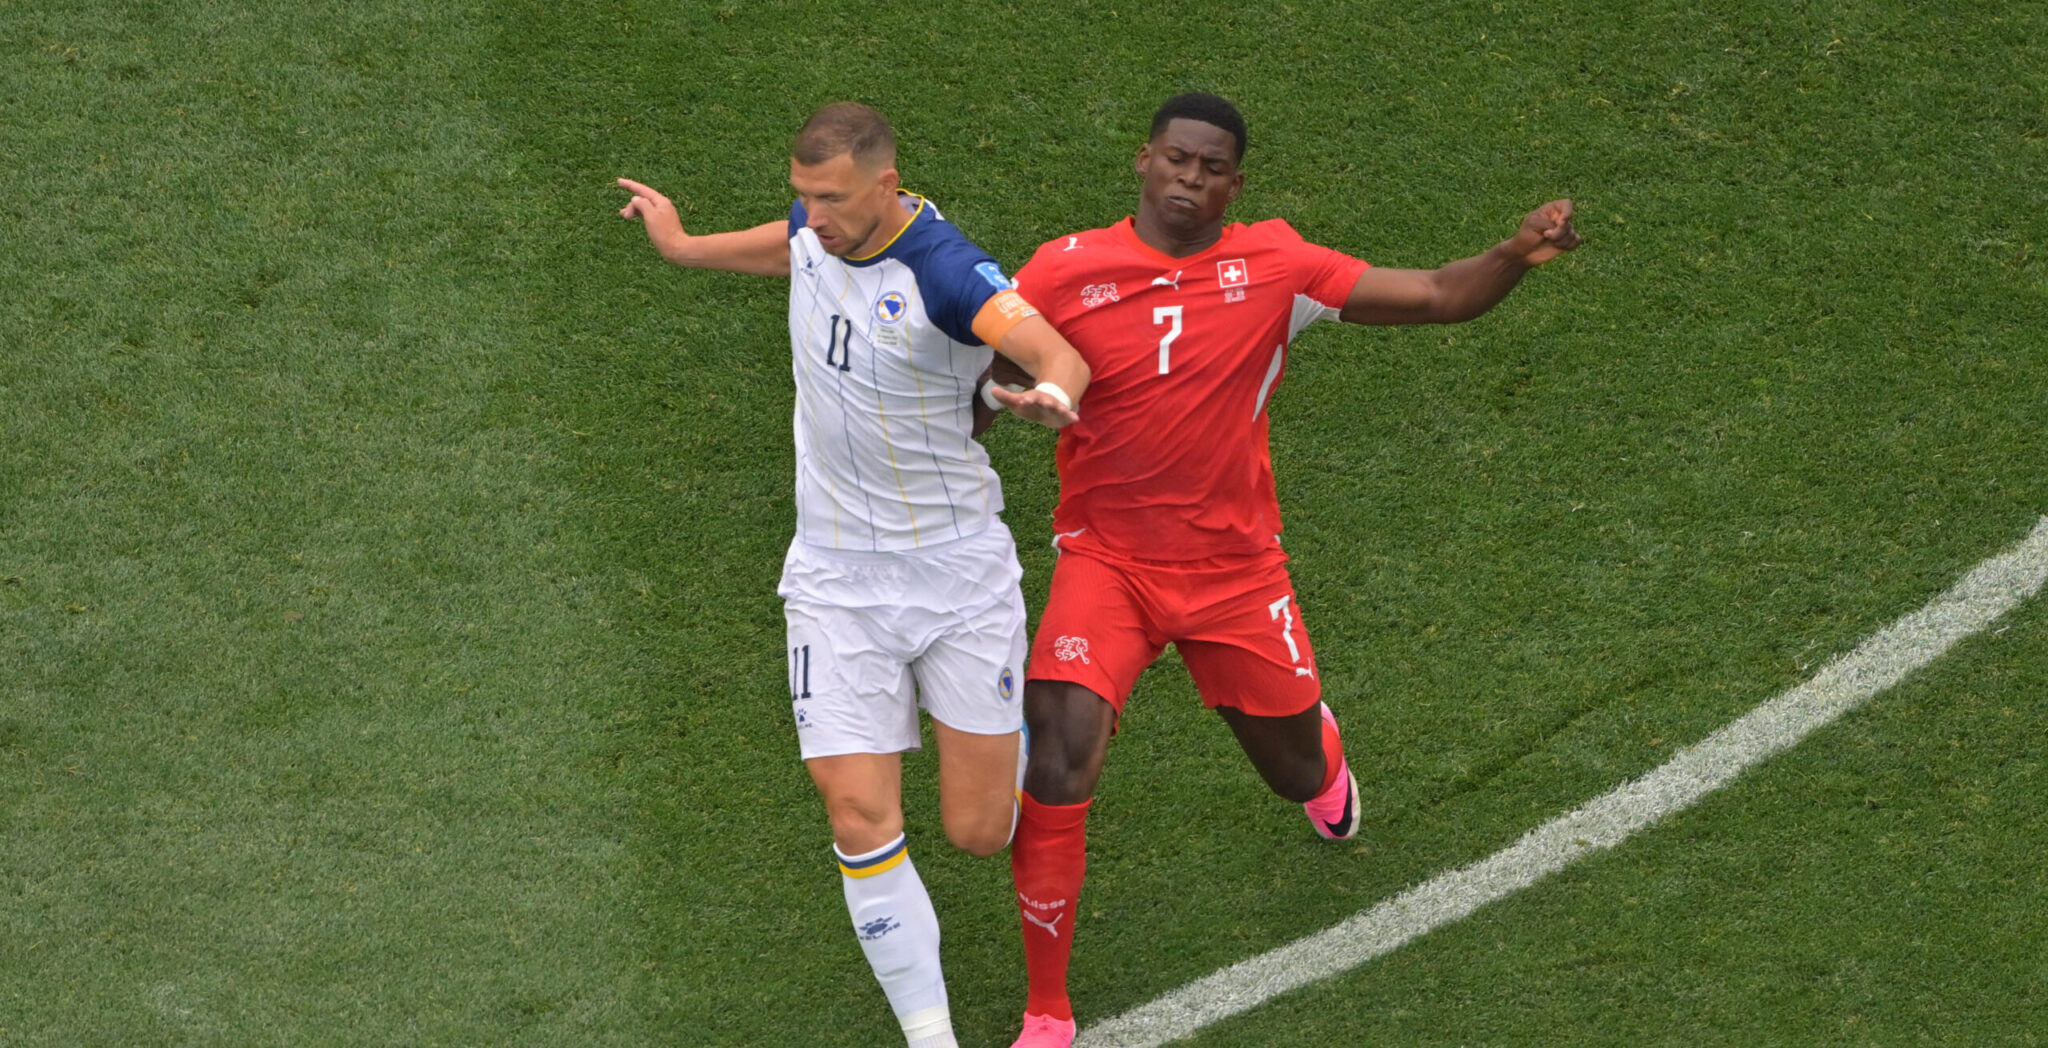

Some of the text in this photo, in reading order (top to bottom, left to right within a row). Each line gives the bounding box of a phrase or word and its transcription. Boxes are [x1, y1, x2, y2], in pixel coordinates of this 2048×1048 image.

[826, 314, 852, 373] 11
[1153, 305, 1184, 375] 7
[1268, 594, 1301, 663] 7
[792, 644, 811, 701] 11
